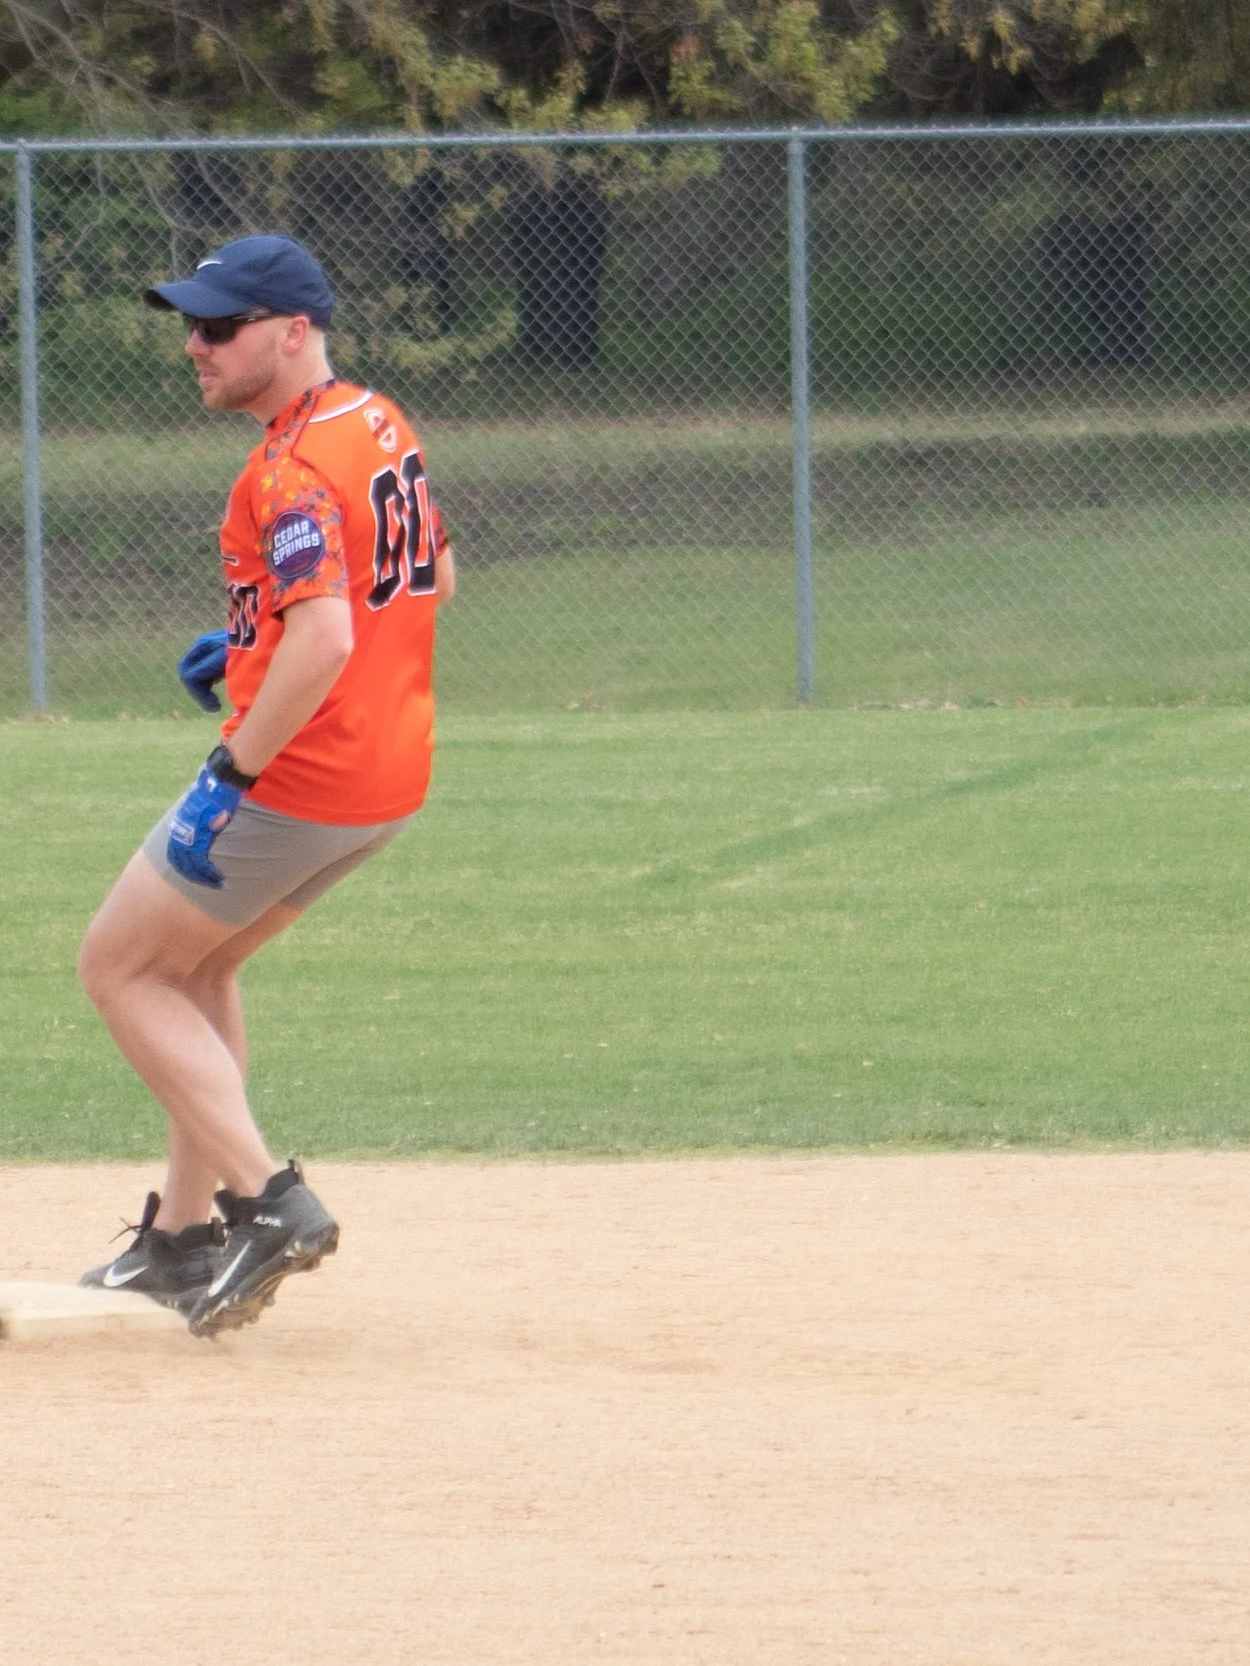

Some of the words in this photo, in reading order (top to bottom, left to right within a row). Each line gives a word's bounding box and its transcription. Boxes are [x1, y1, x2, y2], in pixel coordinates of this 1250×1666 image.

[274, 520, 310, 549] CEDAR
[367, 447, 438, 612] 00
[273, 532, 320, 566] SPRINGS
